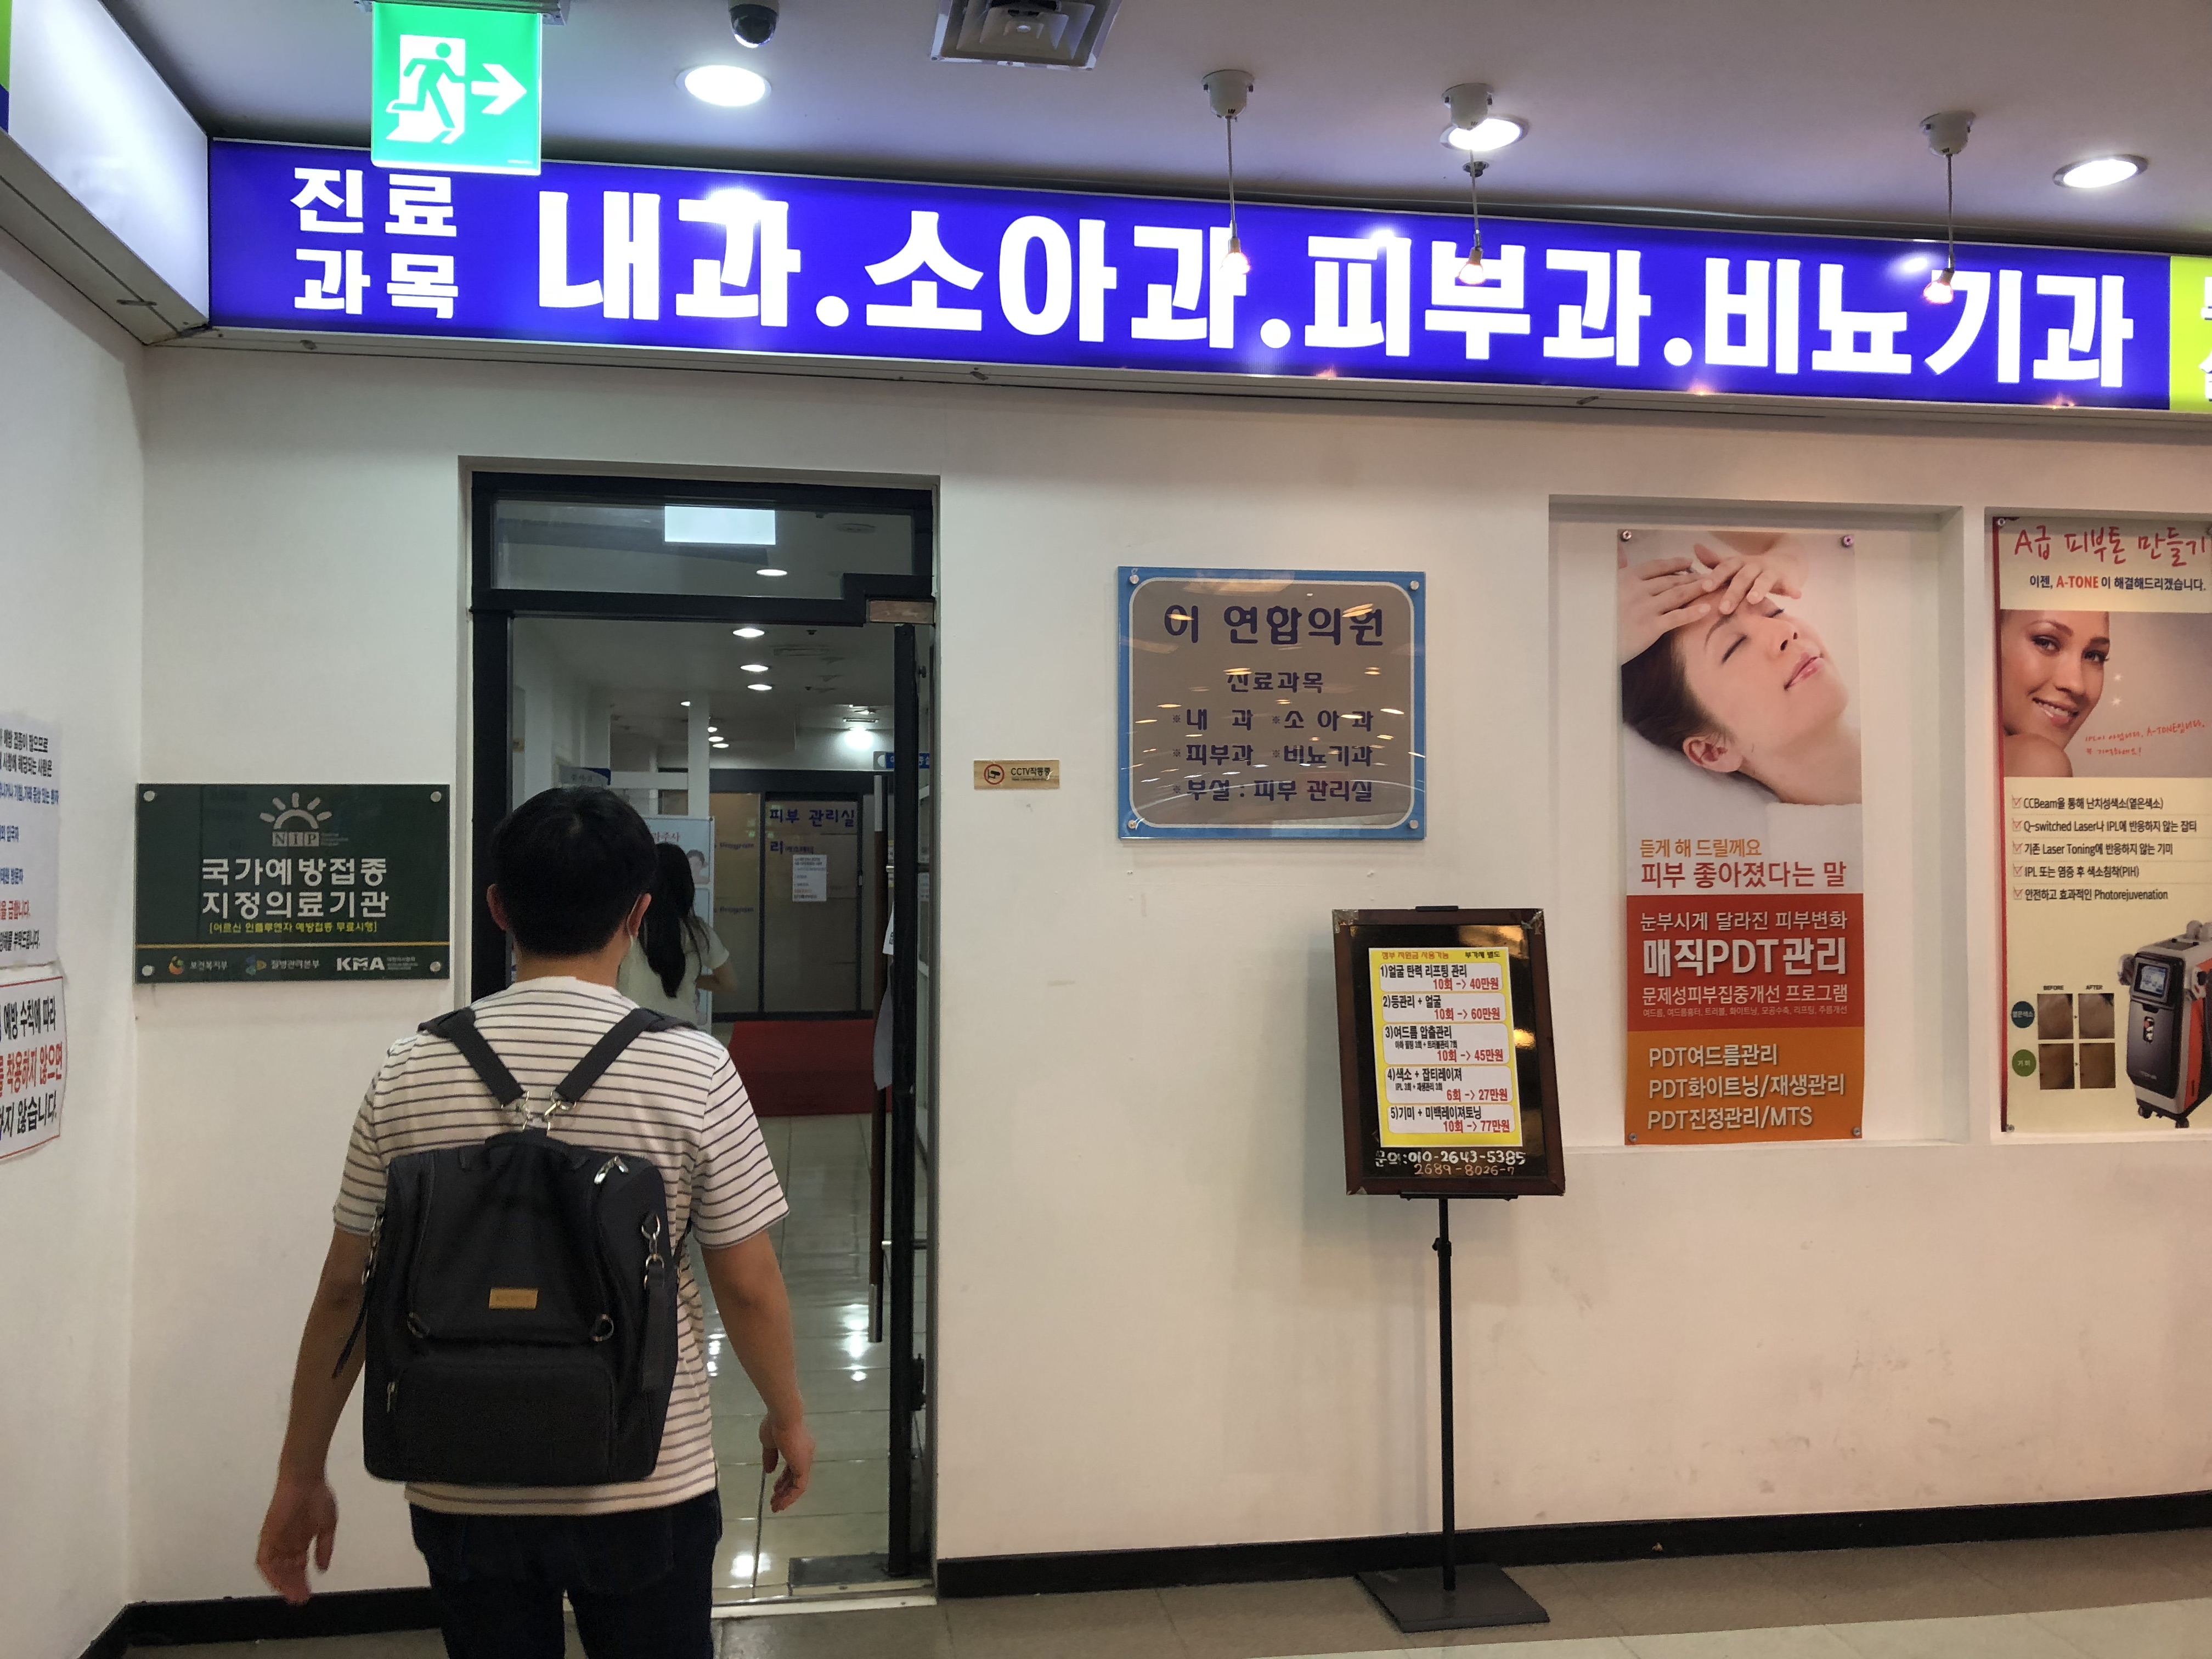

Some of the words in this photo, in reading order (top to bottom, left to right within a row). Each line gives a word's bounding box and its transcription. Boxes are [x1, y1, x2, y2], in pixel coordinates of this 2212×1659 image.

[291, 167, 456, 237] 진료
[294, 249, 459, 319] 과목
[2014, 525, 2051, 560] A급
[2064, 526, 2126, 565] 피부톤
[2138, 527, 2206, 567] 만들기
[2029, 575, 2053, 590] 이젠,
[2056, 575, 2099, 589] A-TONE
[2101, 575, 2111, 589] 이
[2114, 577, 2207, 591] 해결해드리겠습니다.
[1164, 605, 1199, 644] 이
[1223, 605, 1384, 646] 연합의원
[1186, 744, 1253, 766] 피부과
[1283, 745, 1373, 767] 비뇨기과
[1011, 767, 1051, 776] CCTV작동중
[1254, 780, 1297, 802] 피부
[1306, 780, 1373, 803] 관리실
[2023, 797, 2065, 810] CCBeam을
[2068, 797, 2084, 810] 통해
[770, 809, 800, 823] 피부
[809, 809, 855, 827] 관리실
[2023, 821, 2072, 833] Q-switched
[2074, 821, 2104, 832] Laser나
[2106, 820, 2127, 832] IPL에
[2129, 821, 2160, 832] 반응하지
[2163, 821, 2179, 832] 않는
[1640, 839, 1670, 858] 듣게
[1675, 838, 1691, 857] 해
[1695, 838, 1762, 857] 드릴께요
[2024, 843, 2040, 855] 기존
[2042, 844, 2064, 855] Laser
[2067, 843, 2103, 857] Toning에
[2106, 843, 2137, 855] 반응하지
[2140, 843, 2155, 855] 않는
[2157, 843, 2174, 855] 기미
[202, 858, 387, 887] 국가예방접종
[1641, 861, 1685, 889] 피부
[1693, 861, 1814, 888] 좋아졌다는
[1824, 861, 1847, 887] 말
[2024, 866, 2038, 878] IPL
[2040, 866, 2056, 878] 또는
[2058, 866, 2074, 878] 염증
[2076, 866, 2085, 878] 후
[2025, 889, 2057, 901] 안전하고
[2059, 889, 2092, 901] 효과적인
[2094, 888, 2168, 901] Photorejuvenation
[202, 891, 390, 919] 지정의료기관
[1640, 911, 1708, 932] 눈부시게
[1716, 911, 1768, 931] 달라진
[1775, 910, 1847, 930] 피부변화
[336, 956, 385, 972] KMA
[1407, 964, 1423, 978] 탄력
[1425, 964, 1448, 978] 리프팅
[1451, 964, 1468, 978] 관리
[1433, 978, 1453, 991] 10회
[1470, 977, 1499, 990] 40만원
[1425, 995, 1442, 1008] 얼굴
[1642, 985, 1780, 1006] 문제성피부집중개선
[1785, 984, 1848, 1003] 프로그램
[1434, 1008, 1454, 1020] 10회
[1471, 1007, 1500, 1020] 60만원
[1420, 1025, 1452, 1039] 압출관리
[1437, 1050, 1457, 1062] 10회
[1474, 1049, 1504, 1062] 45만원
[1649, 1043, 1778, 1068] PDT여드름관리
[7, 1047, 37, 1093] 착용하지
[40, 1041, 62, 1085] 않으면
[1422, 1068, 1462, 1081] 잡티레이져
[1649, 1073, 1844, 1099] PDT화이트닝/재생관리
[1446, 1089, 1462, 1102] 6회
[1479, 1088, 1508, 1102] 27만원
[17, 1090, 57, 1135] 않습니다.
[1425, 1105, 1482, 1120] 미백레이져토닝
[1647, 1105, 1813, 1130] PDT진정관리/MTS
[1443, 1120, 1463, 1133] 10회
[1480, 1119, 1510, 1133] 77만원
